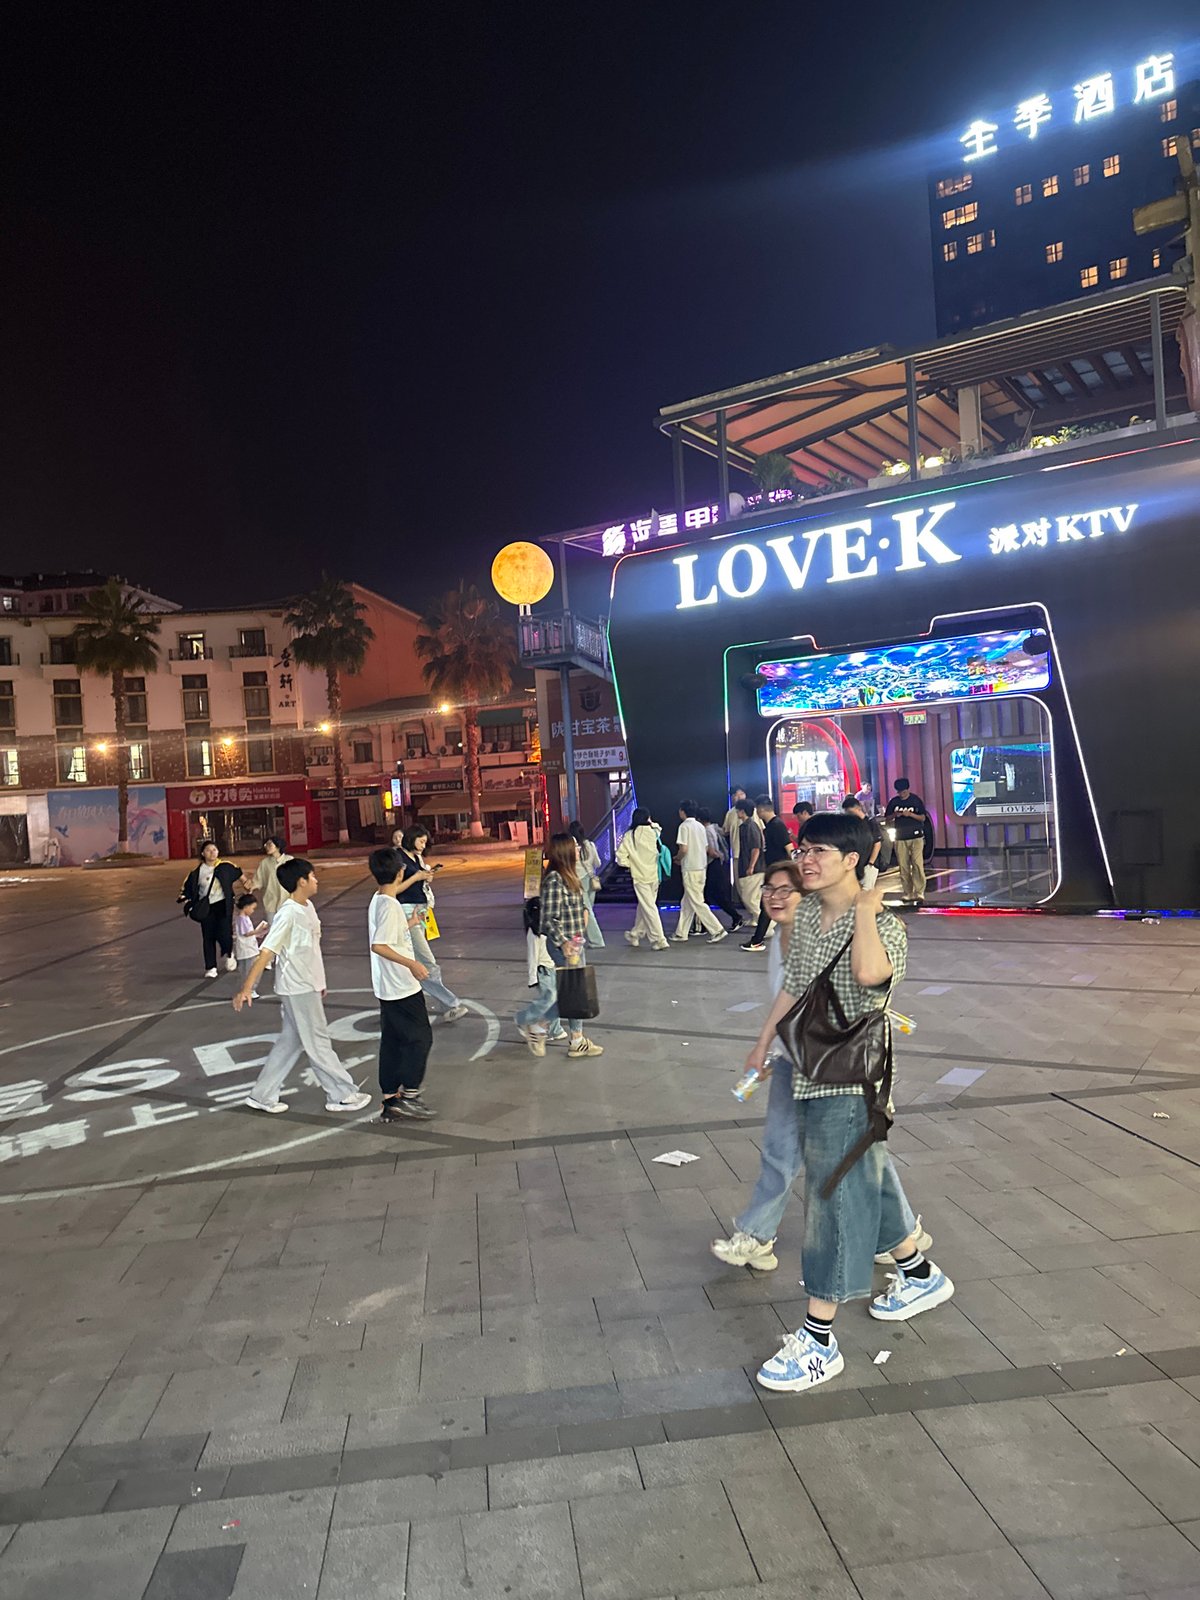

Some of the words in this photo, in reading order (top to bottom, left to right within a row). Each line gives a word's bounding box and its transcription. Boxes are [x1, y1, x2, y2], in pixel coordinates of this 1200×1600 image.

[959, 53, 1174, 162] 全季酒店
[278, 700, 297, 708] ART
[807, 1356, 825, 1383] NY
